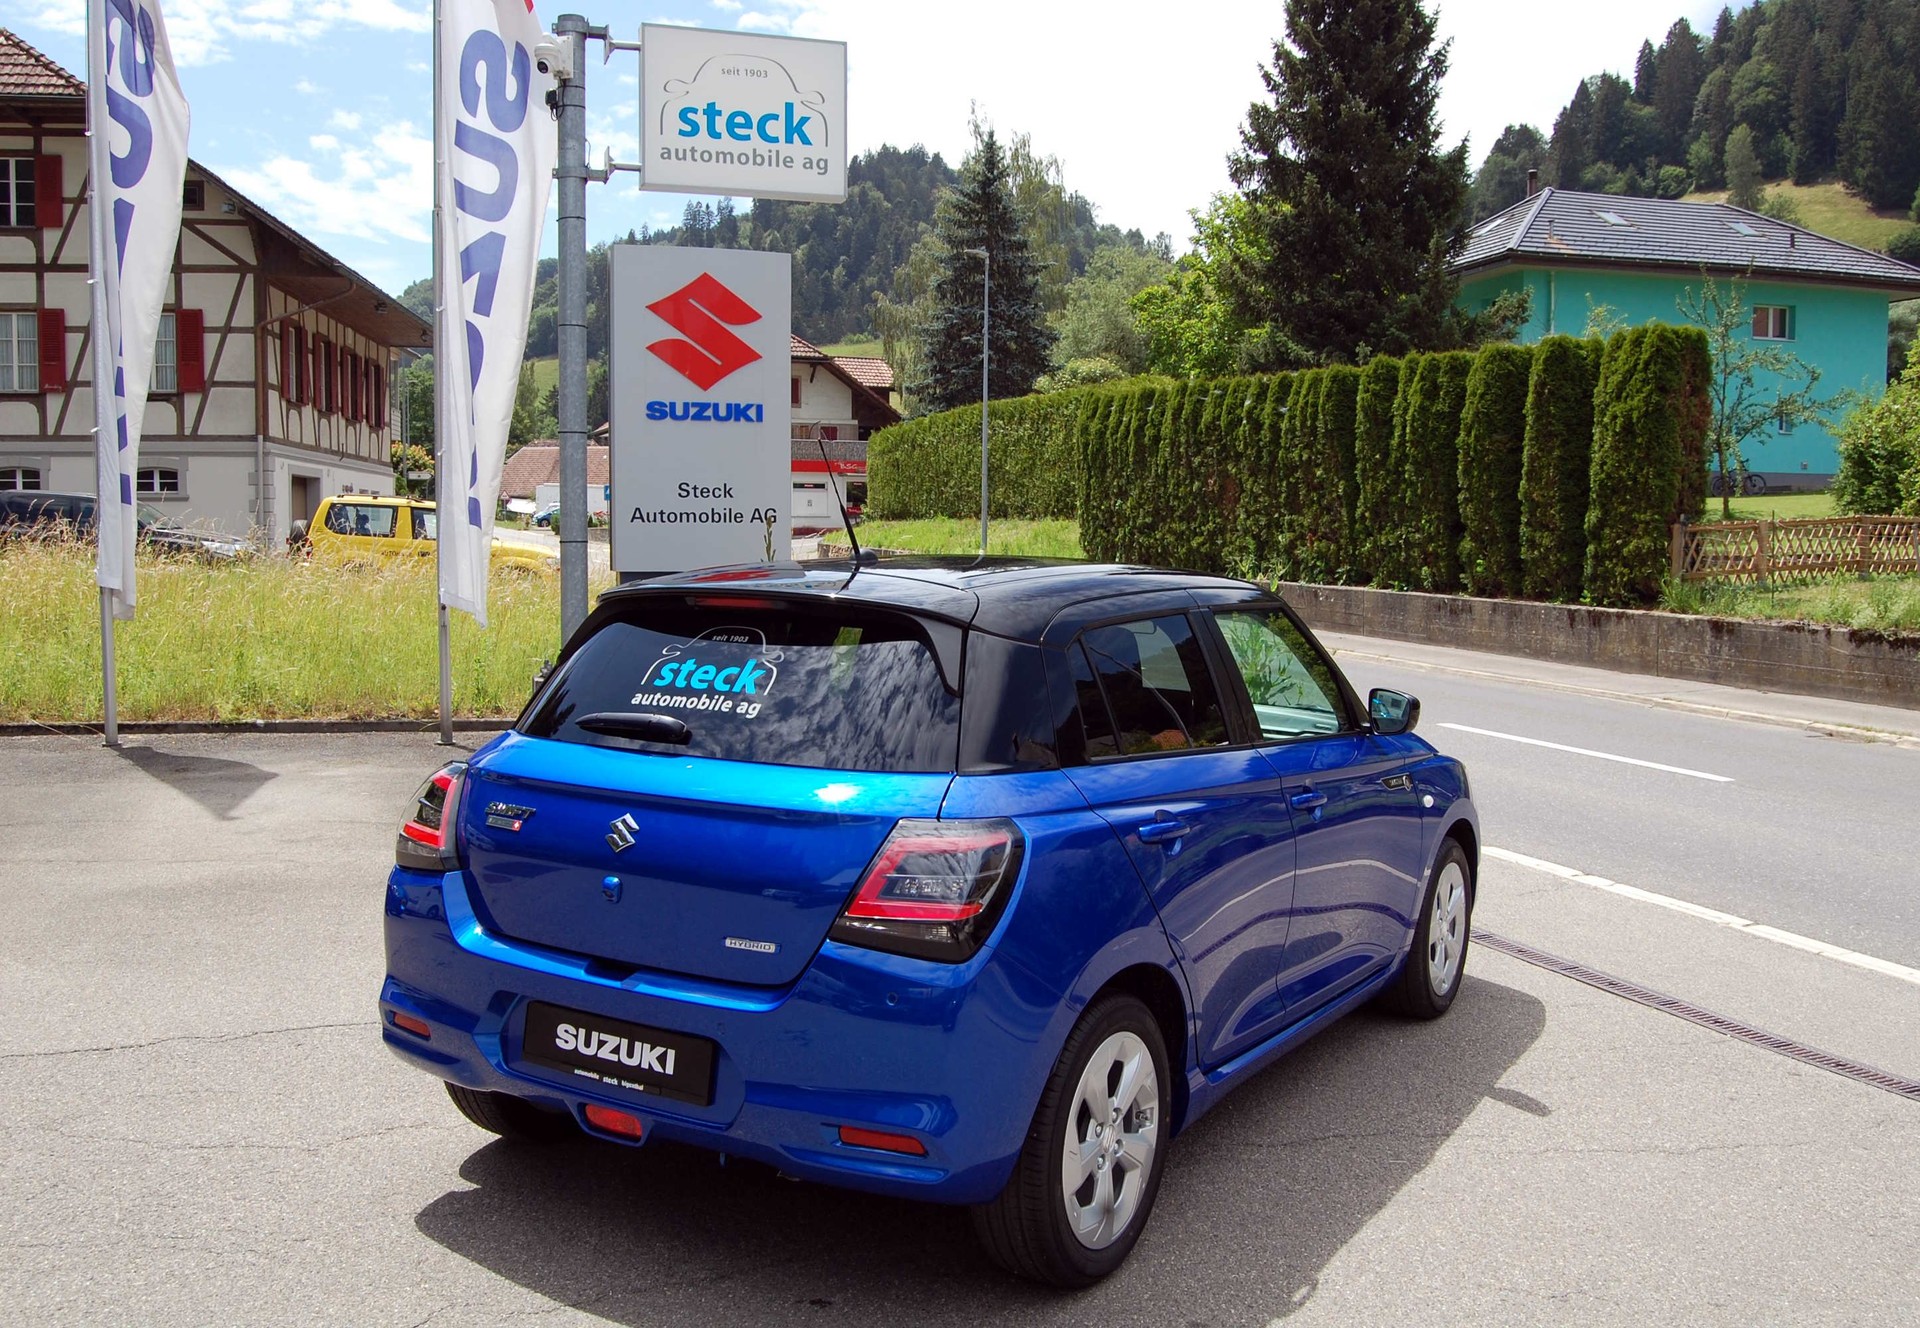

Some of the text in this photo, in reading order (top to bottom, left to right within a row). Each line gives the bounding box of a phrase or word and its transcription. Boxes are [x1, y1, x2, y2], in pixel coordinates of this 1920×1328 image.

[721, 67, 768, 78] seit 1903
[678, 101, 813, 146] steck
[660, 146, 828, 175] automobile ag
[646, 401, 763, 423] SUZUKI
[677, 482, 734, 498] Steck
[630, 507, 777, 523] Automobile AG
[729, 635, 749, 643] 1903
[653, 658, 767, 695] steck
[631, 692, 762, 719] automobile ag
[729, 940, 772, 951] HYBRID
[555, 1023, 676, 1075] SUZUKI
